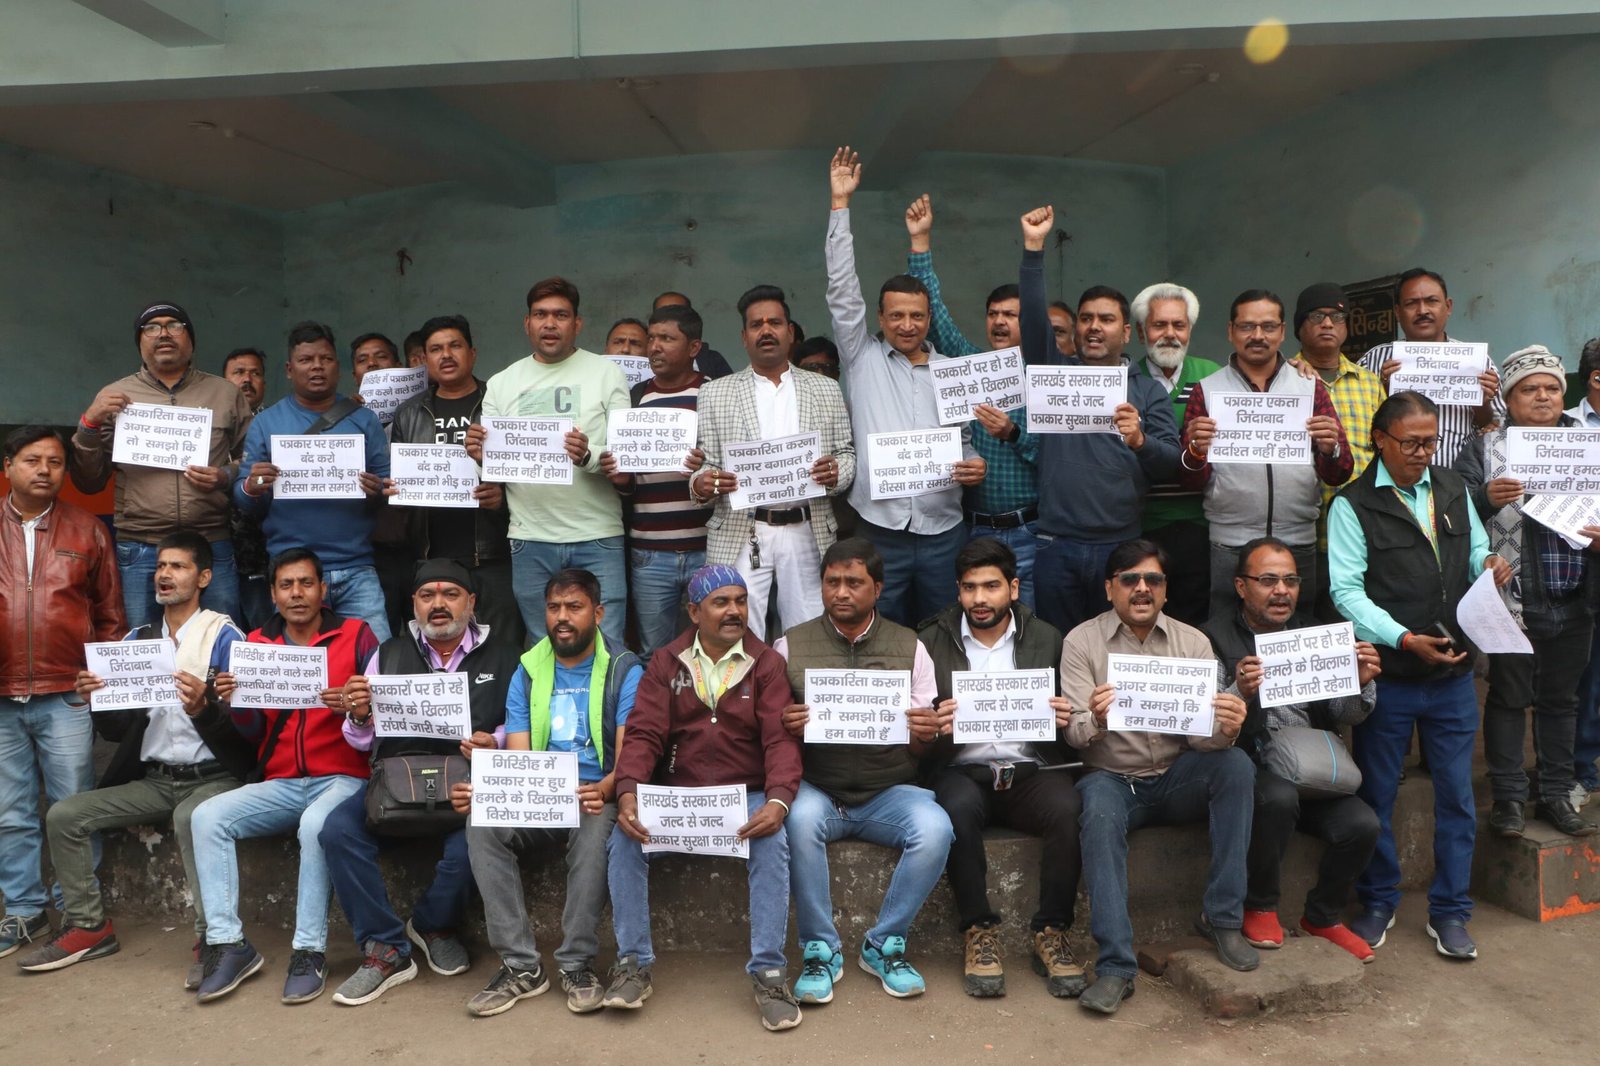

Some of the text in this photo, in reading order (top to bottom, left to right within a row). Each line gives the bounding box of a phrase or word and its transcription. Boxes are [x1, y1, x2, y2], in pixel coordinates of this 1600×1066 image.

[1405, 346, 1474, 355] पत्रकार एकता
[934, 354, 1017, 379] पत्रकारों पर हो रहे
[1031, 372, 1066, 388] झारखंड
[1068, 375, 1101, 387] सरकार
[1432, 375, 1447, 384] पर
[940, 375, 1019, 399] हमले के खिलाफ
[1430, 387, 1476, 398] नहीं होगा
[554, 386, 572, 413] C
[1047, 392, 1105, 407] जल्द से जल्द
[1224, 397, 1299, 408] पत्रकार एकता
[177, 413, 207, 423] करना
[626, 411, 679, 423] गिरिडीह में
[1031, 414, 1090, 430] पत्रकार सुरक्षा
[123, 422, 151, 433] अगर
[194, 427, 202, 439] है
[492, 421, 559, 432] पत्रकार एकता
[617, 429, 686, 441] पत्रकार पर हुए
[876, 432, 951, 446] पत्रकार पर हमला
[1522, 432, 1600, 443] पत्रकार एकता
[126, 435, 197, 452] तो समझो कि
[280, 439, 355, 449] पत्रकार पर हमला
[728, 437, 816, 457] पत्रकारिता करना
[317, 451, 335, 463] करो
[399, 448, 443, 457] पत्रकार पर
[914, 446, 932, 458] करो
[1253, 444, 1276, 458] नहीं
[1278, 444, 1305, 458] होगा
[434, 461, 451, 472] करो
[620, 455, 681, 467] विरोध प्रदर्शन
[733, 463, 762, 472] अगर
[806, 451, 813, 464] है
[521, 464, 542, 478] नहीं
[544, 465, 568, 478] होगा
[874, 463, 921, 477] पत्रकार को
[1511, 464, 1571, 474] पत्रकार पर
[310, 484, 326, 492] मत
[328, 480, 356, 493] समझो
[426, 490, 472, 502] मत समझो
[1260, 628, 1349, 656] पत्रकारों पर हो रहे
[96, 644, 161, 656] पत्रकार एकता
[234, 647, 322, 663] गिरिडीह में पत्रकार पर
[260, 666, 321, 677] करने वाले सभी
[1113, 661, 1211, 677] पत्रकारिता करना
[371, 680, 463, 696] पत्रकारों पर हो रहे
[872, 678, 905, 688] करना
[957, 676, 993, 693] झारखंड
[995, 677, 1029, 690] सरकार
[1115, 681, 1147, 692] अगर
[1197, 682, 1206, 696] है
[1266, 677, 1352, 700] संघर्ष जारी रहेगा
[132, 688, 152, 702] नहीं
[813, 694, 844, 703] अगर
[892, 692, 901, 706] है
[377, 700, 462, 717] हमले के खिलाफ
[818, 708, 896, 723] तो समझो कि
[958, 718, 1050, 738] पत्रकार सुरक्षा कानून
[1125, 716, 1145, 726] हम
[492, 756, 555, 770] गिरिडीह में
[482, 776, 566, 791] पत्रकार पर हुए
[642, 791, 678, 808] झारखंड
[681, 795, 718, 808] सरकार
[486, 807, 564, 822] विरोध प्रदर्शन
[660, 813, 724, 828] जल्द से जल्द
